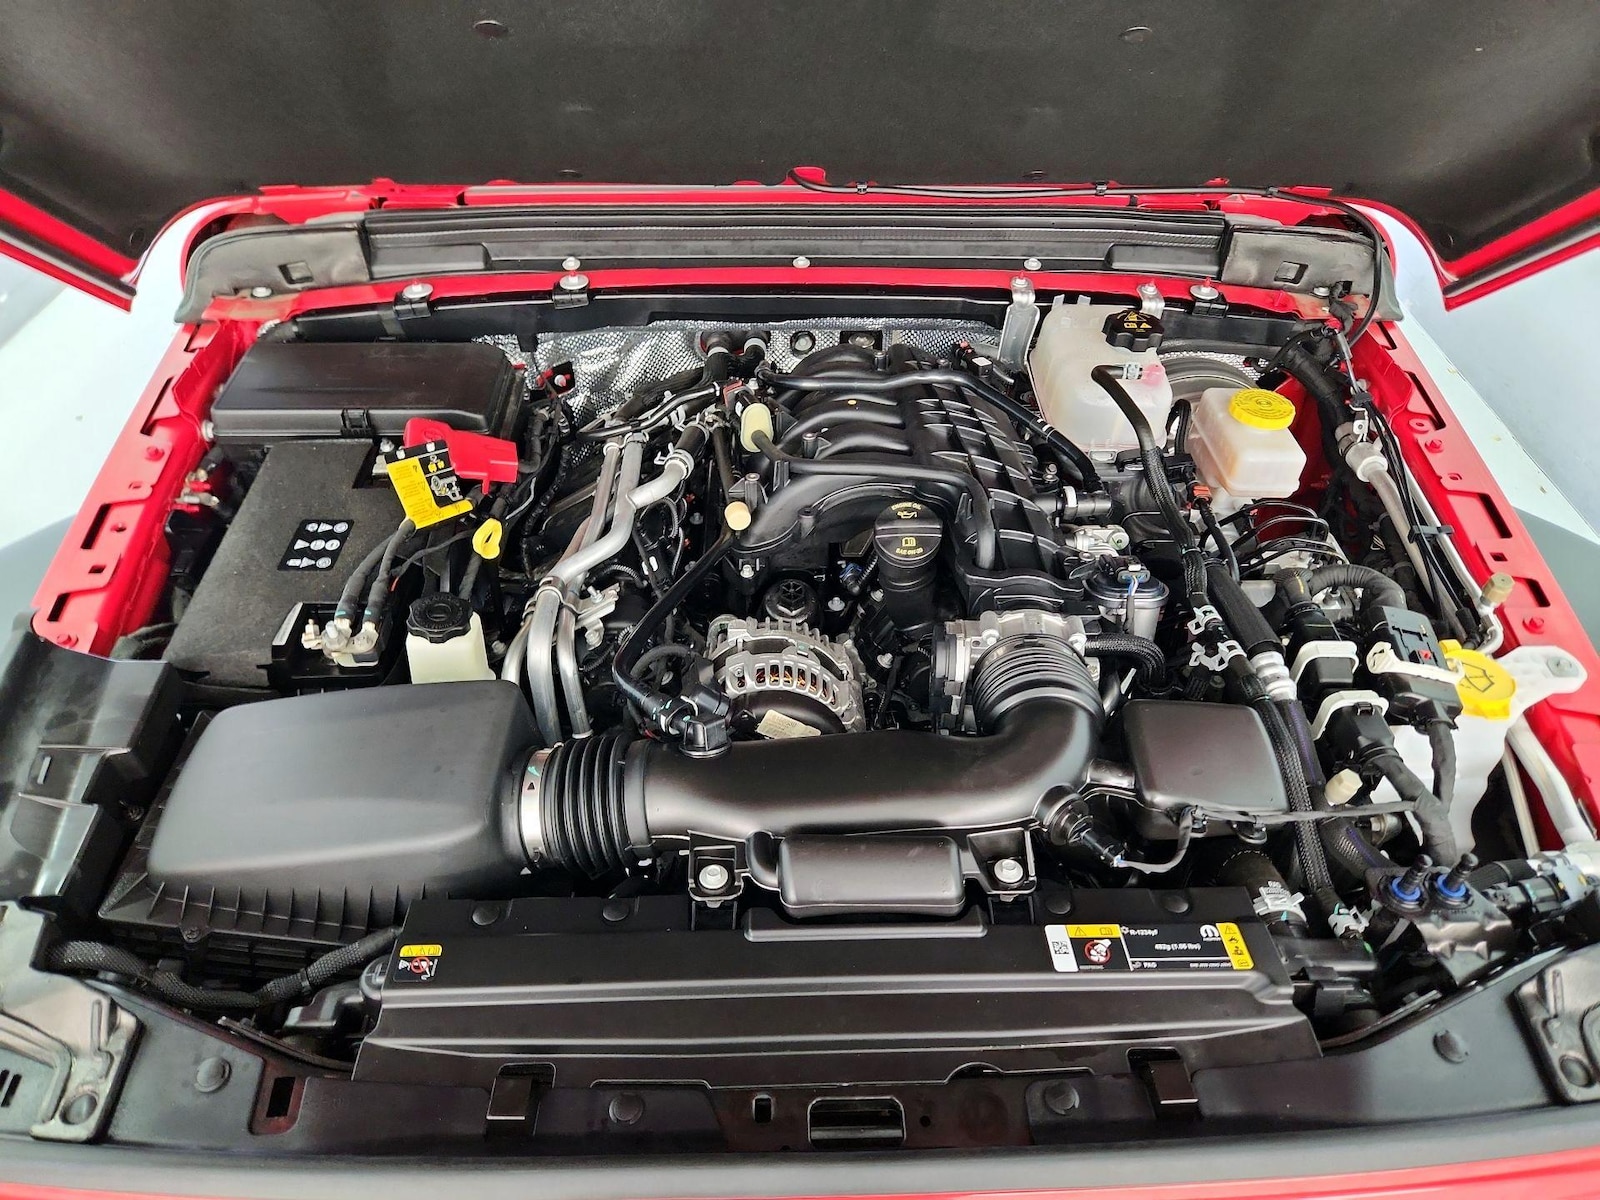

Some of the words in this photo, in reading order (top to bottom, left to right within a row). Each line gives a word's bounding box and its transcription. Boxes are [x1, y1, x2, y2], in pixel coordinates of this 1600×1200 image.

[891, 501, 912, 510] ENGINE
[912, 502, 922, 510] OIL
[895, 547, 907, 555] SAE
[1129, 929, 1158, 937] R-1234yf
